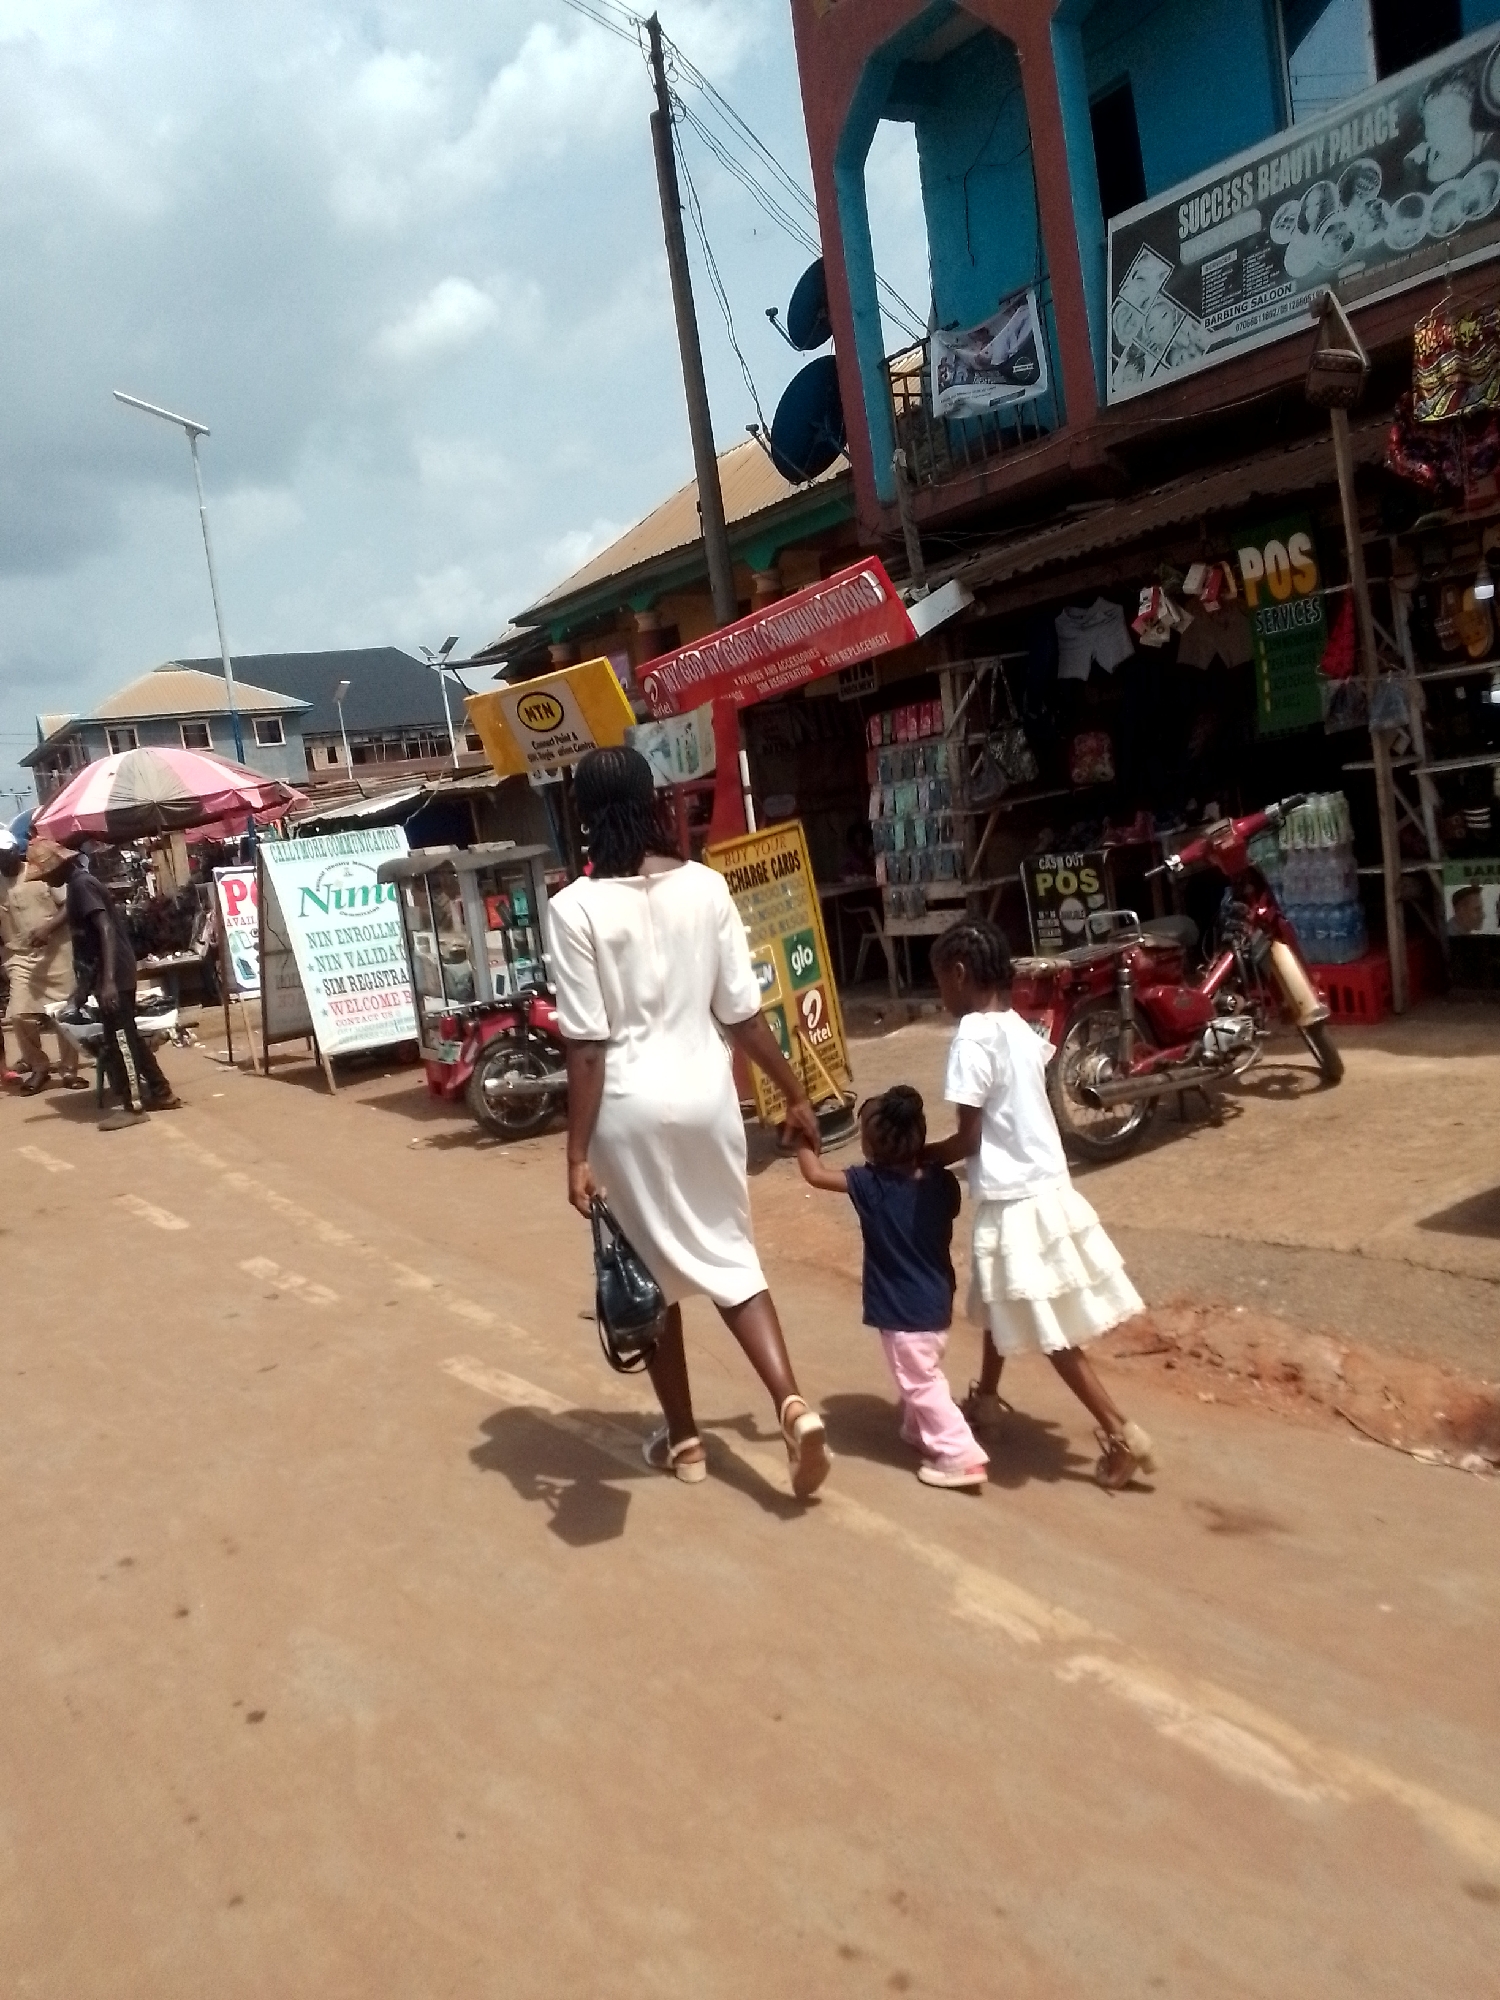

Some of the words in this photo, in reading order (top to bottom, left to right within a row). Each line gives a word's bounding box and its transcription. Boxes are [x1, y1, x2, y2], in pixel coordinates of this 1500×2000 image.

[1178, 172, 1255, 239] SUCCESS
[1257, 139, 1327, 200] BEAUTY
[1328, 101, 1400, 167] PALACE
[1204, 301, 1249, 329] BARBING
[1249, 284, 1293, 313] SALOON
[1238, 532, 1317, 608] POS
[1255, 596, 1322, 635] SERVICES
[660, 668, 682, 693] MY
[679, 655, 706, 690] GOD
[703, 646, 725, 676] MY
[721, 631, 763, 669] GLORY
[759, 577, 879, 652] COMMUNICATIONS
[839, 632, 892, 660] REPLACEMENT
[770, 664, 814, 690] REGISTRATION
[524, 702, 556, 722] MTN
[652, 702, 673, 717] airtel
[724, 848, 750, 868] BUY
[753, 835, 788, 858] YOUR
[1065, 851, 1084, 868] OUT
[724, 861, 768, 897] ECHARGE
[770, 849, 802, 880] CARDS
[1036, 868, 1099, 896] POS
[305, 929, 335, 950] NIN
[316, 952, 342, 973] NIN
[791, 944, 814, 976] glo
[322, 977, 345, 997] SIM
[350, 967, 410, 992] REGISTRA
[328, 992, 400, 1017] WELCOME
[336, 1014, 379, 1028] CONTACT
[382, 1011, 393, 1020] US
[806, 1021, 834, 1046] irtel
